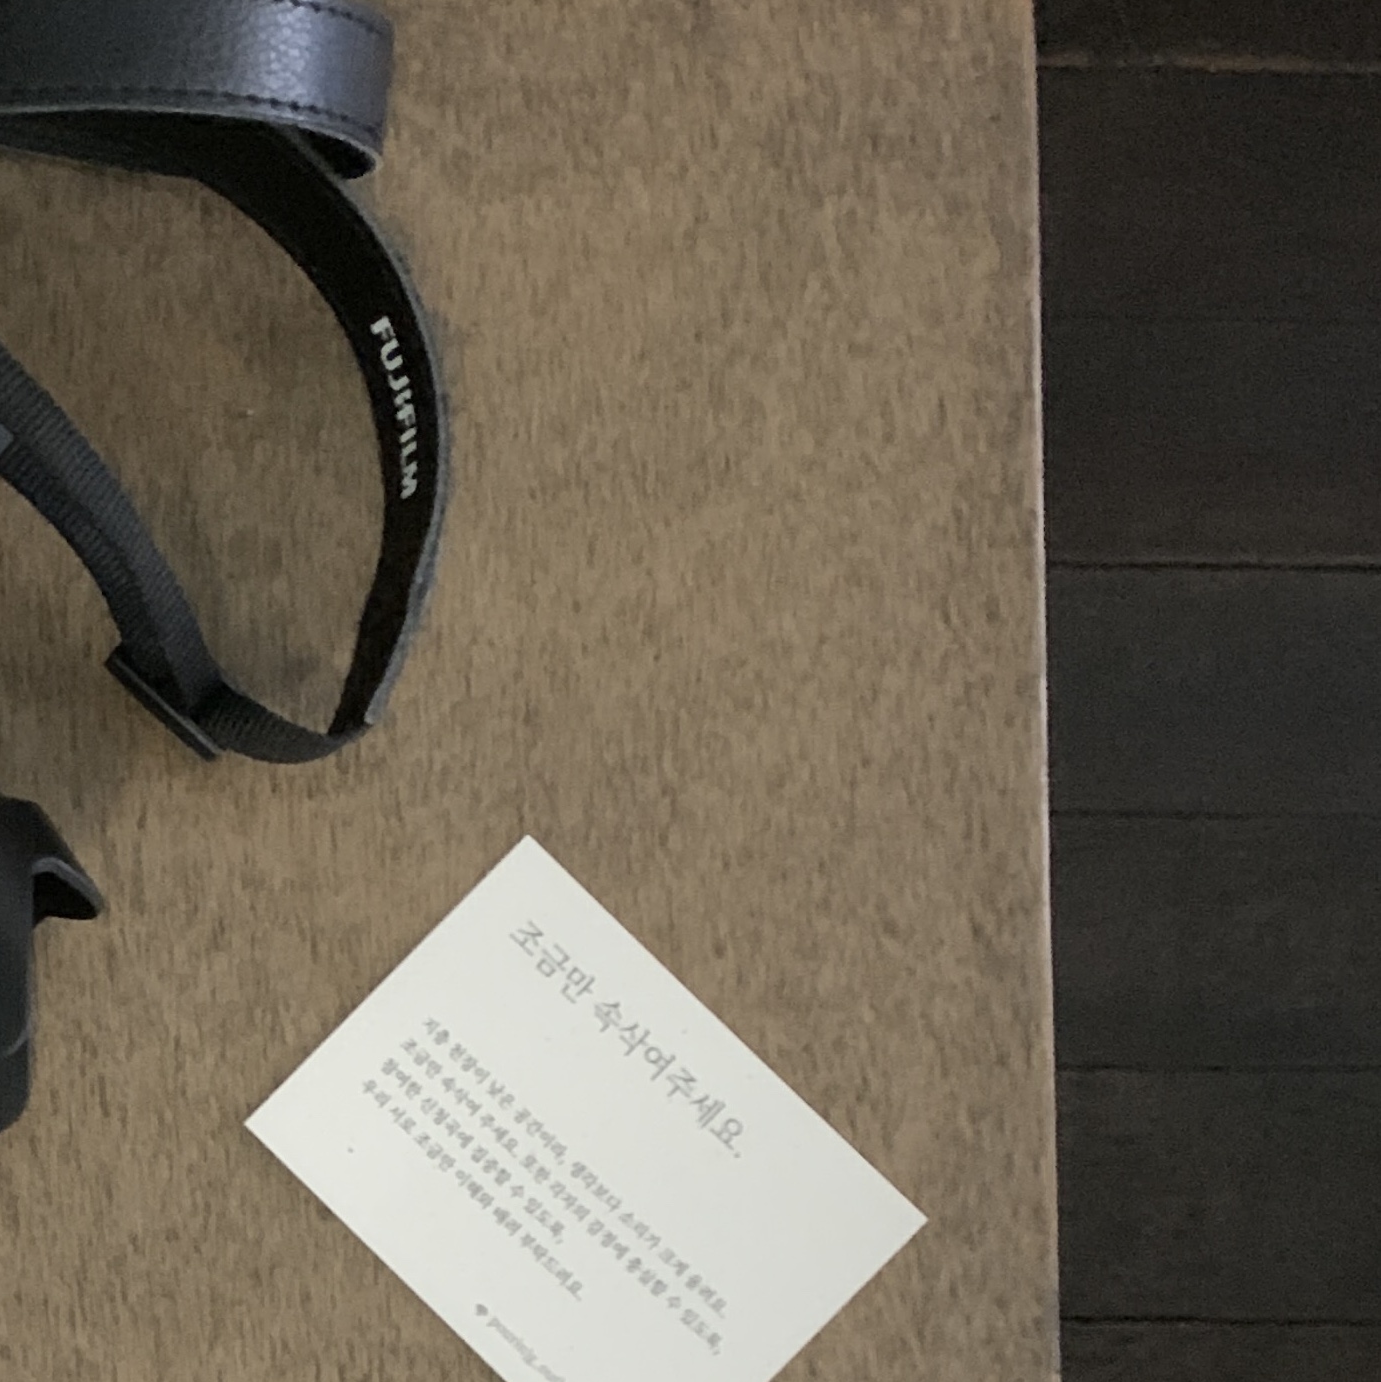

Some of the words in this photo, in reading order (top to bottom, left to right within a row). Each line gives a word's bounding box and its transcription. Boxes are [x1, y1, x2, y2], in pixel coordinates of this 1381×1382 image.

[370, 315, 418, 500] FUJIFILM
[506, 917, 598, 1006] 조금만
[588, 996, 751, 1160] 속삭여주세요.
[360, 1077, 392, 1109] 우리
[411, 1129, 457, 1173] 조금만
[398, 1036, 443, 1080] 조금만
[438, 1075, 483, 1118] 속삭여
[663, 1293, 683, 1311] 수
[507, 1182, 527, 1201] 수
[568, 1159, 623, 1213] 생각보다
